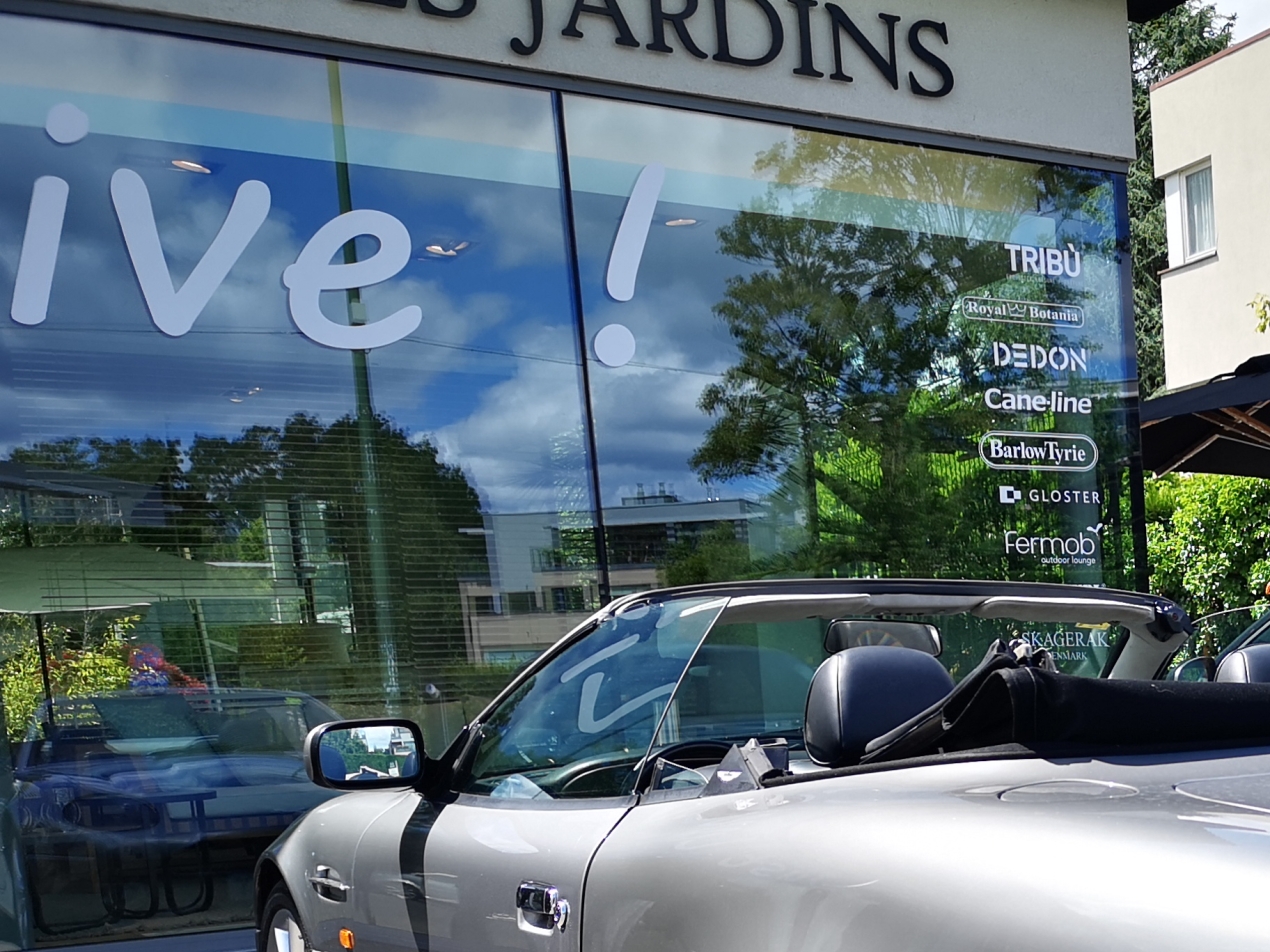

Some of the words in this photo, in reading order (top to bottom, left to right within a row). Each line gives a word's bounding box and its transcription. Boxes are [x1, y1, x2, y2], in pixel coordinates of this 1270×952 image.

[1003, 243, 1081, 278] TRIBÙ
[966, 301, 1007, 318] Royal
[1029, 306, 1079, 323] Botania
[993, 341, 1088, 373] DEDON
[985, 388, 1092, 415] Cane-line
[1029, 488, 1101, 504] GLOSTER
[1004, 531, 1096, 556] Fermob
[1041, 556, 1070, 565] outdoor
[1071, 556, 1096, 566] lounge
[1021, 631, 1110, 648] SKAGERAK
[1050, 651, 1088, 660] ENMARK
